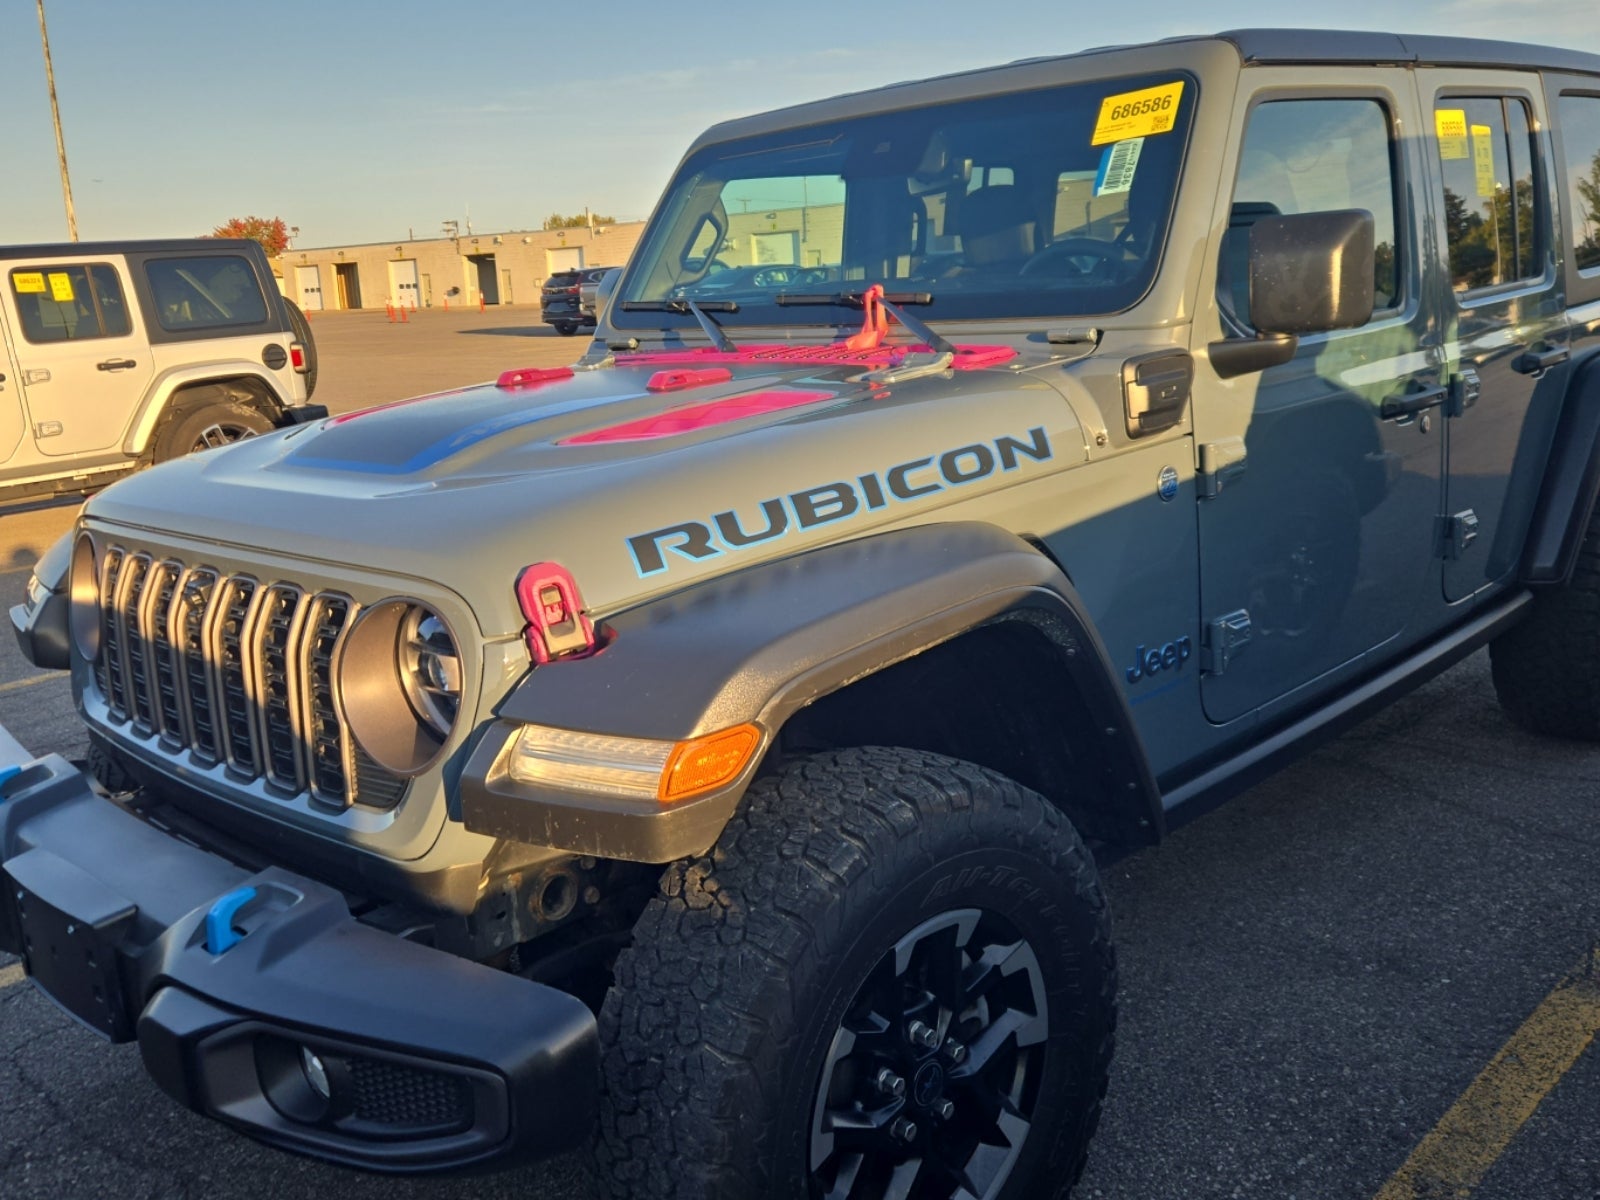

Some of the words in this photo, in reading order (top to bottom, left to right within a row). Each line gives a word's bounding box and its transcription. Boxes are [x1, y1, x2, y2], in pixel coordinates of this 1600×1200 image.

[1111, 94, 1172, 121] 686586
[624, 425, 1054, 579] RUBICON
[1125, 634, 1192, 685] Jeep
